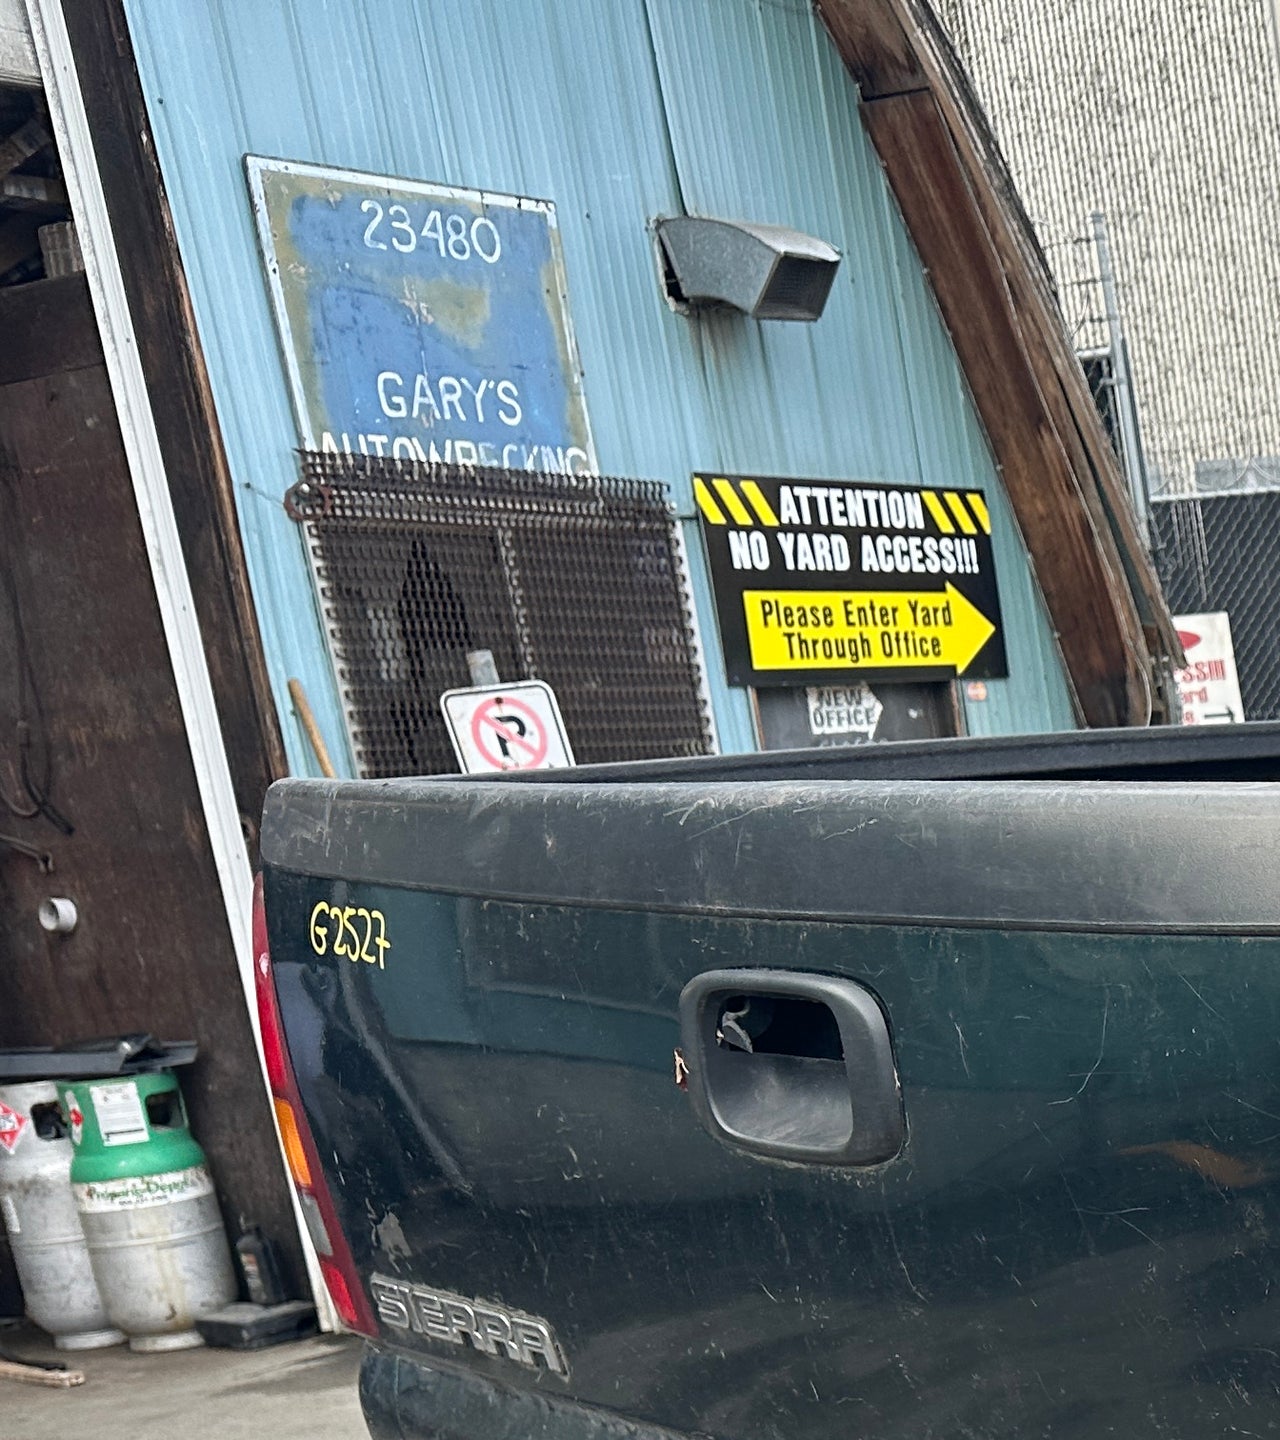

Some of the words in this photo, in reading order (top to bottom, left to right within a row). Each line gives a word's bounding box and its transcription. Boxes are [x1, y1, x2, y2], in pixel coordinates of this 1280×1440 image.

[361, 200, 502, 264] 23480
[376, 371, 523, 426] GARY'S
[779, 484, 925, 530] ATTENTION
[728, 530, 770, 571] NO
[778, 532, 851, 572] YARD
[861, 534, 980, 574] ACCESS!!!
[761, 599, 834, 628] Please
[843, 600, 899, 628] Enter
[908, 601, 953, 627] Yard
[783, 632, 872, 663] Through
[881, 632, 942, 658] Office
[813, 707, 877, 729] OFFICE
[310, 900, 392, 970] G2527
[370, 1272, 571, 1383] SIERRA
